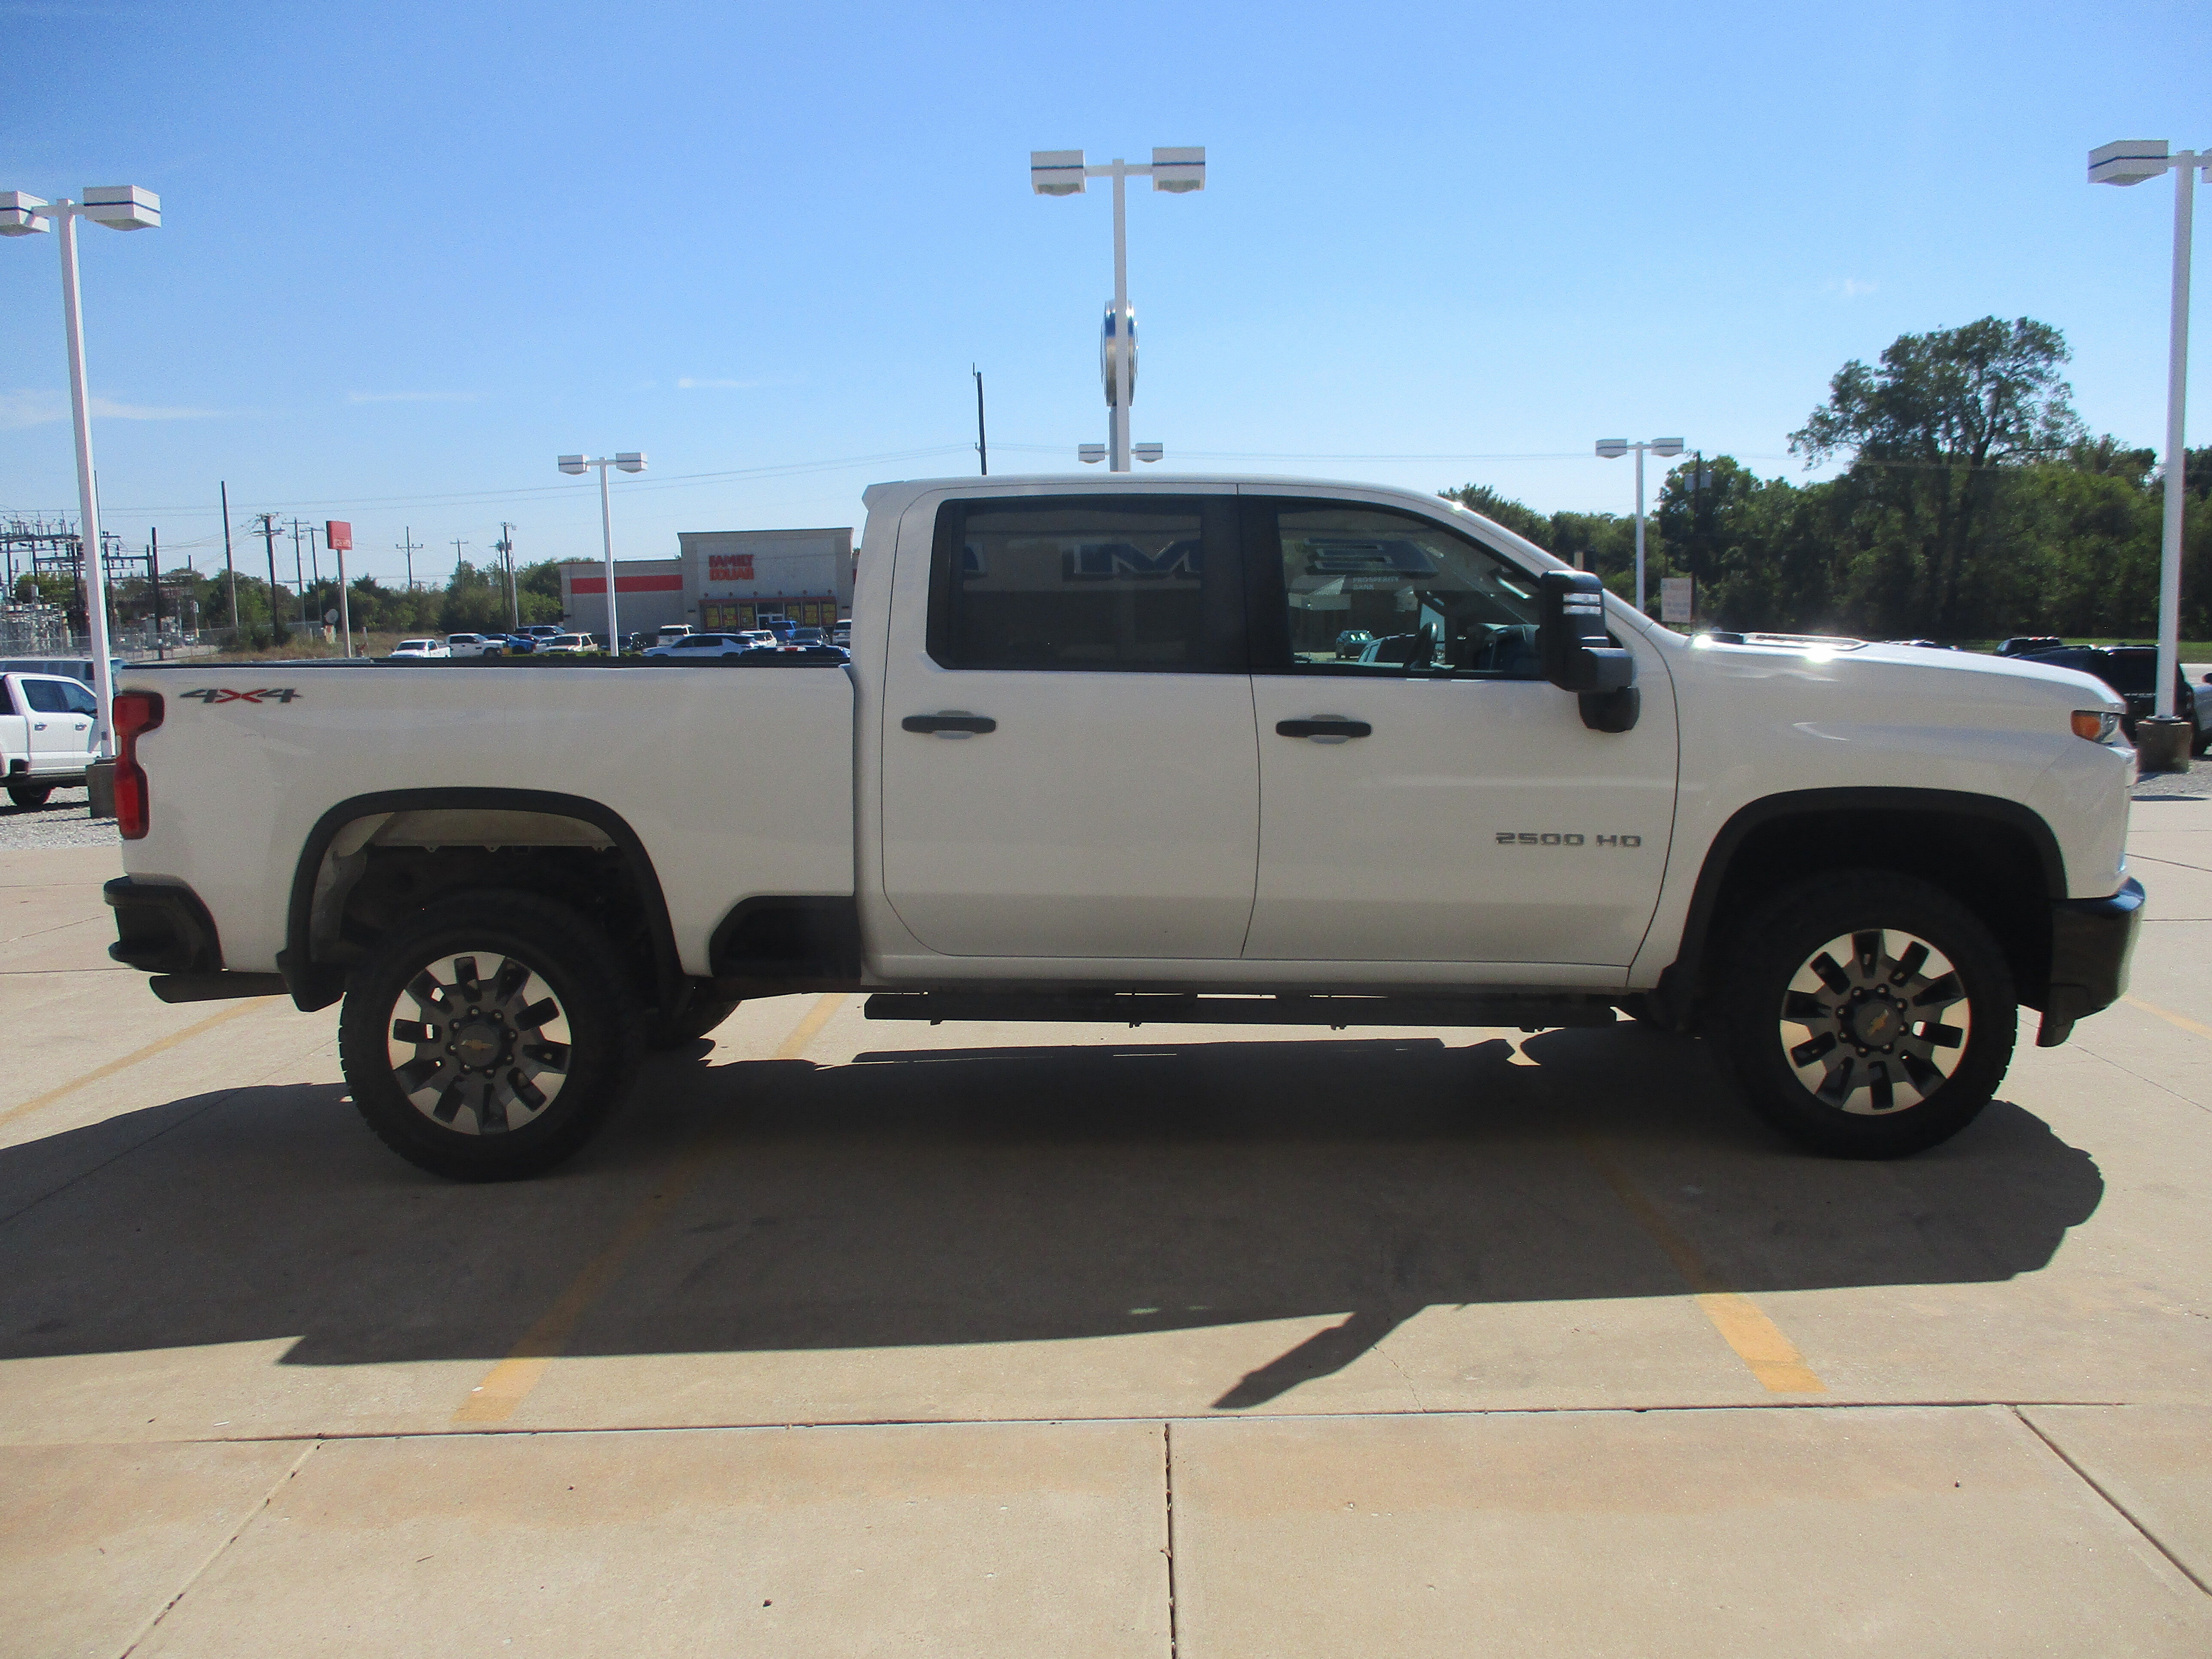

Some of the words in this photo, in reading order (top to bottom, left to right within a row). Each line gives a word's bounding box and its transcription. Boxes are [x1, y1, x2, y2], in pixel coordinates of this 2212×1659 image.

[709, 554, 754, 567] FAMILY
[710, 567, 754, 580] DOLLAR
[1495, 832, 1585, 845] 2500
[1596, 834, 1642, 847] HD
